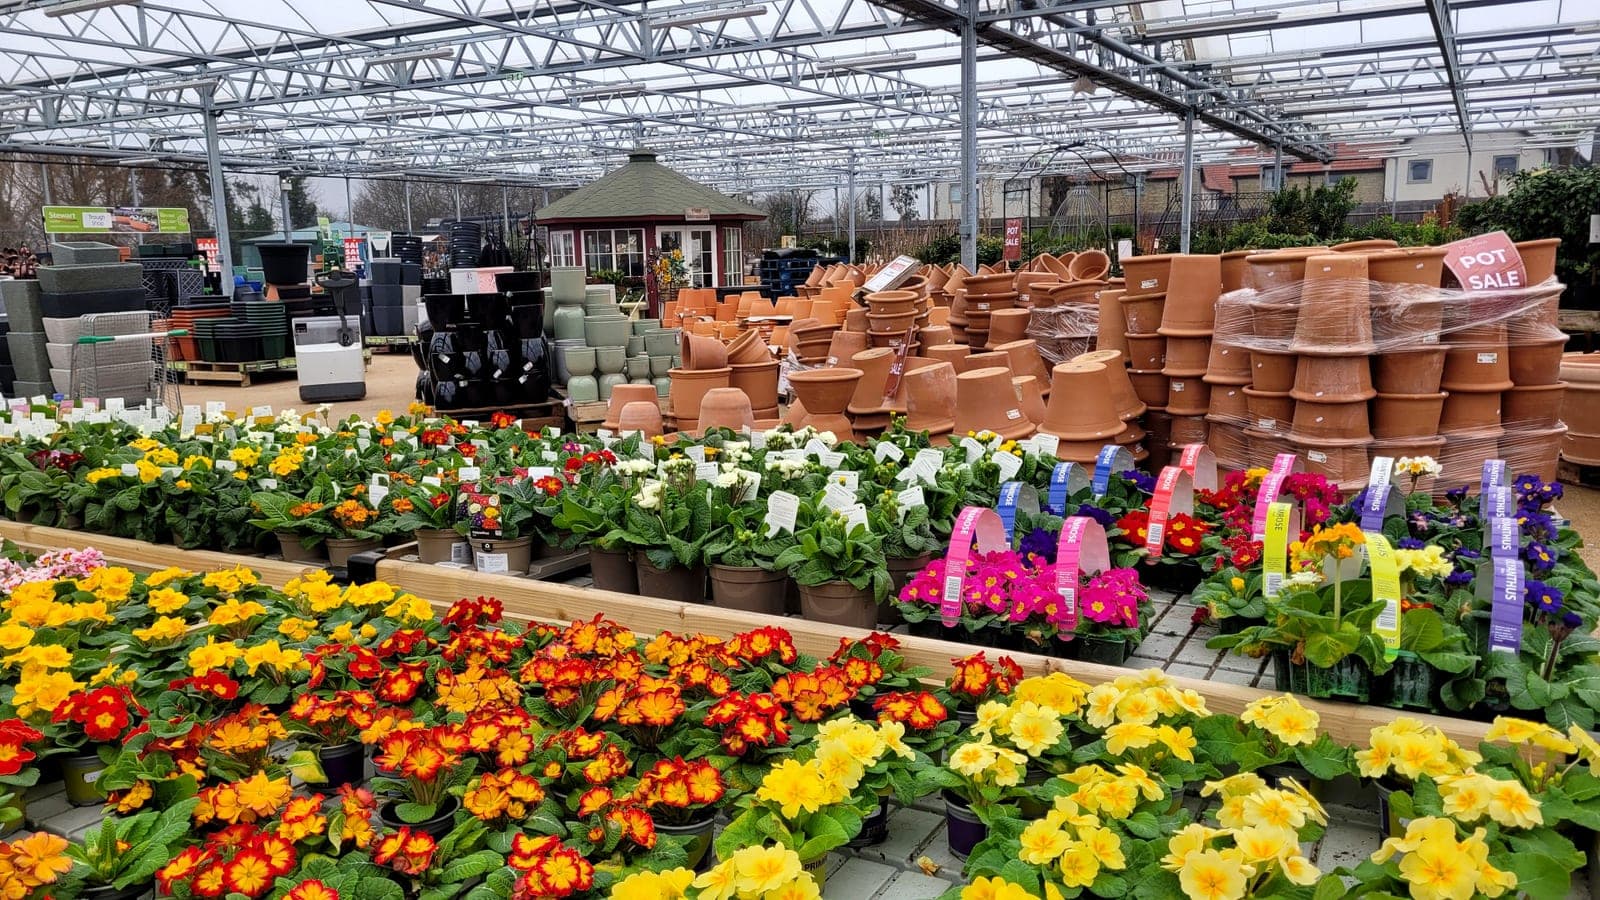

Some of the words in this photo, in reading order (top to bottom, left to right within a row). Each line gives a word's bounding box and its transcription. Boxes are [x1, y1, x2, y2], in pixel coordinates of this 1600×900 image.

[1005, 238, 1019, 246] SALE
[1459, 249, 1506, 268] POT
[1468, 270, 1520, 290] SALE
